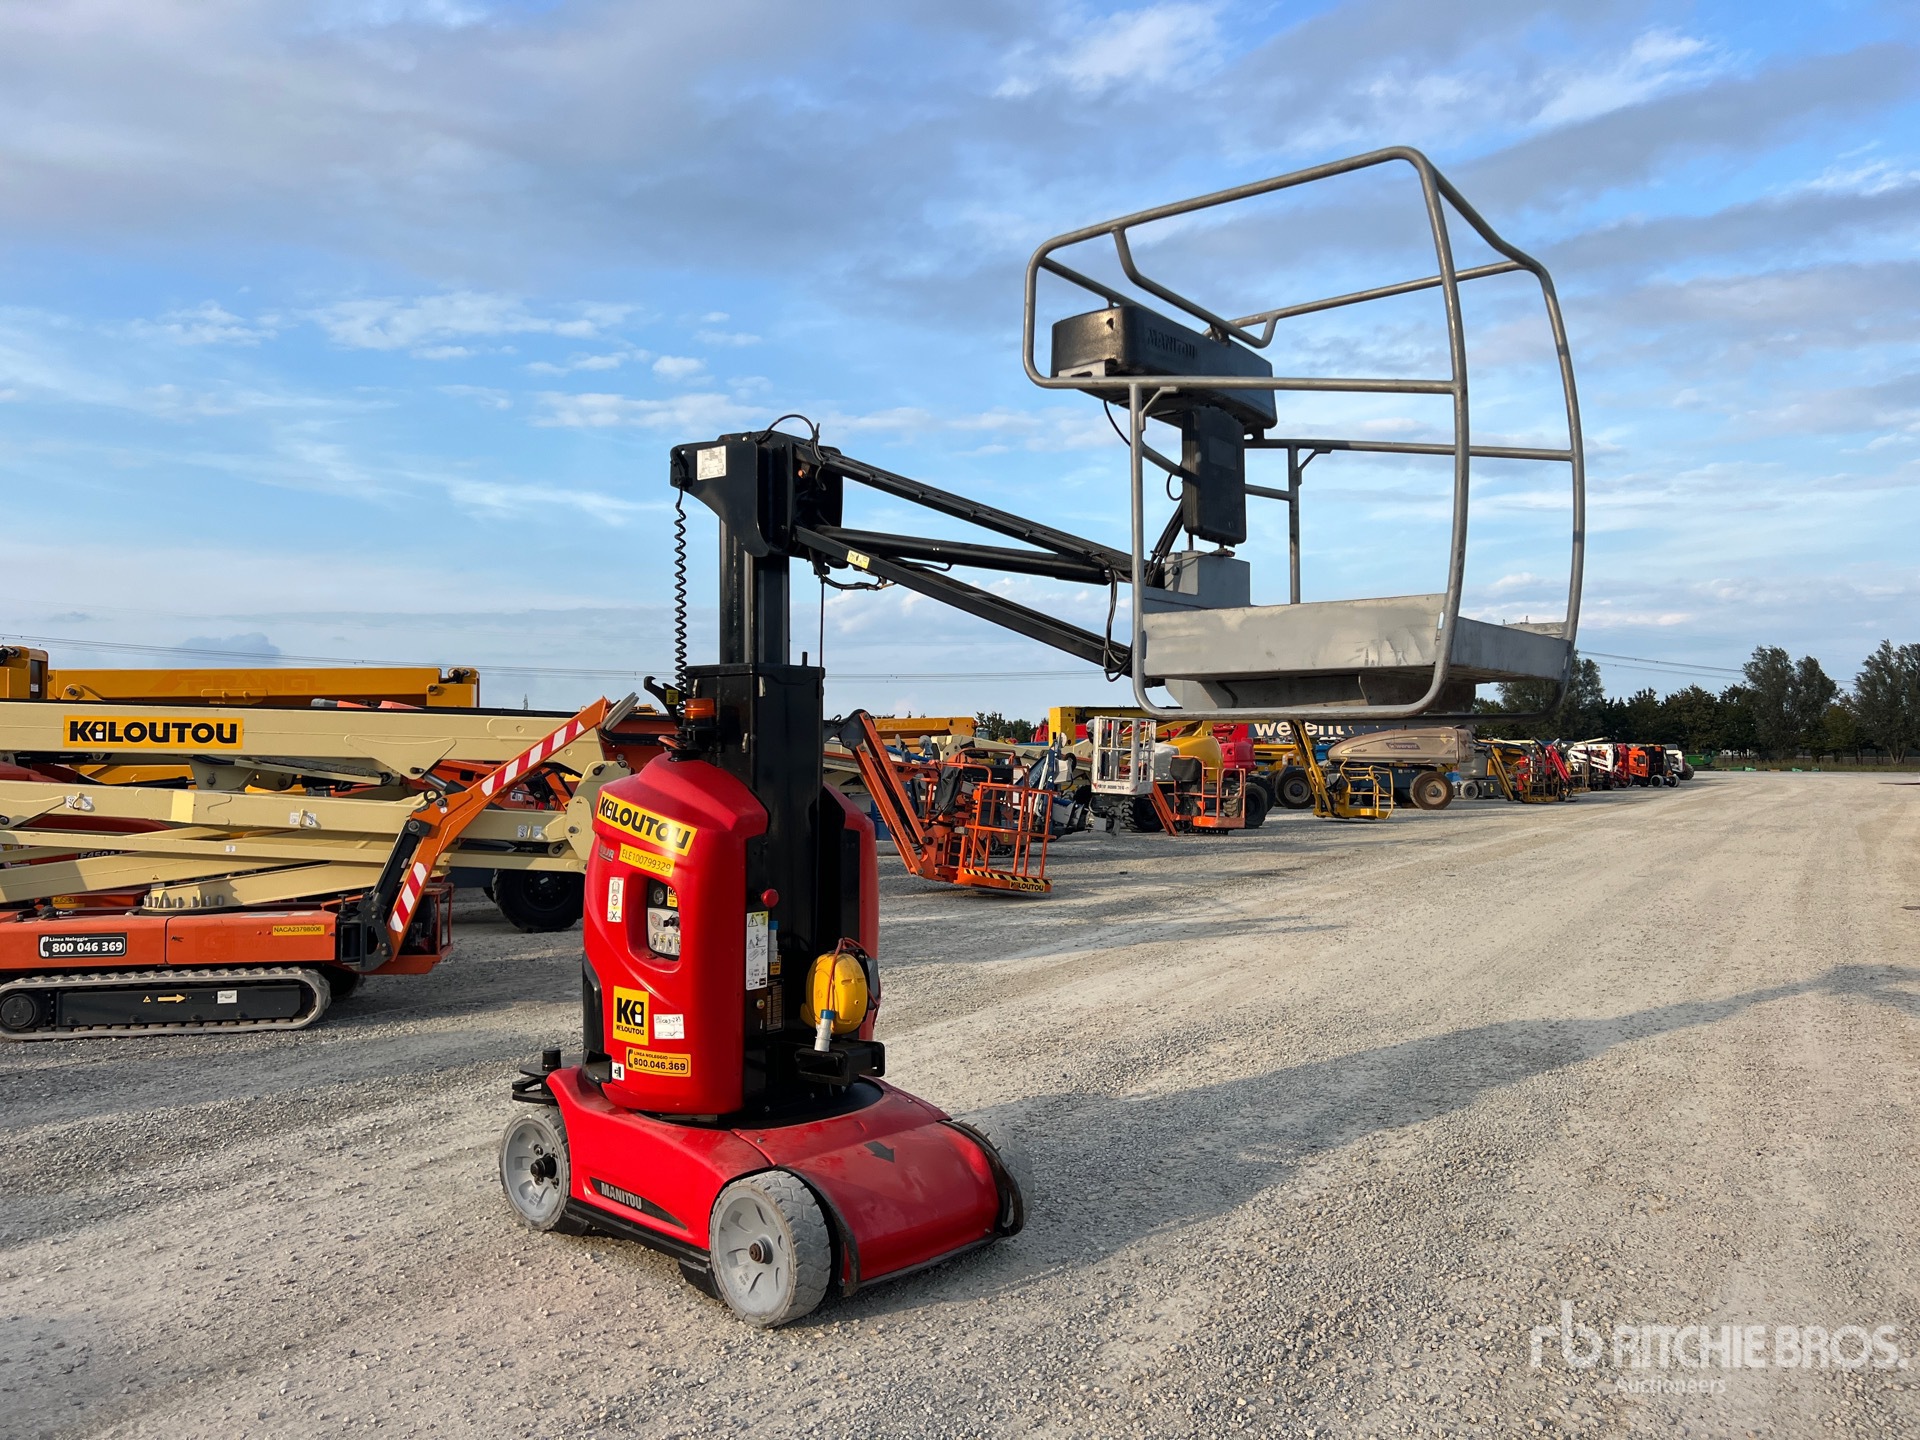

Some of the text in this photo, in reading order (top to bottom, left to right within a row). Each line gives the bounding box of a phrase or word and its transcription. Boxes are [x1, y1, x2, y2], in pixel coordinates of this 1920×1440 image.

[1147, 328, 1198, 359] MANITOU
[52, 941, 123, 953] 800 046 369
[633, 1057, 686, 1071] 800.046.369
[600, 1182, 643, 1210] MANITOU
